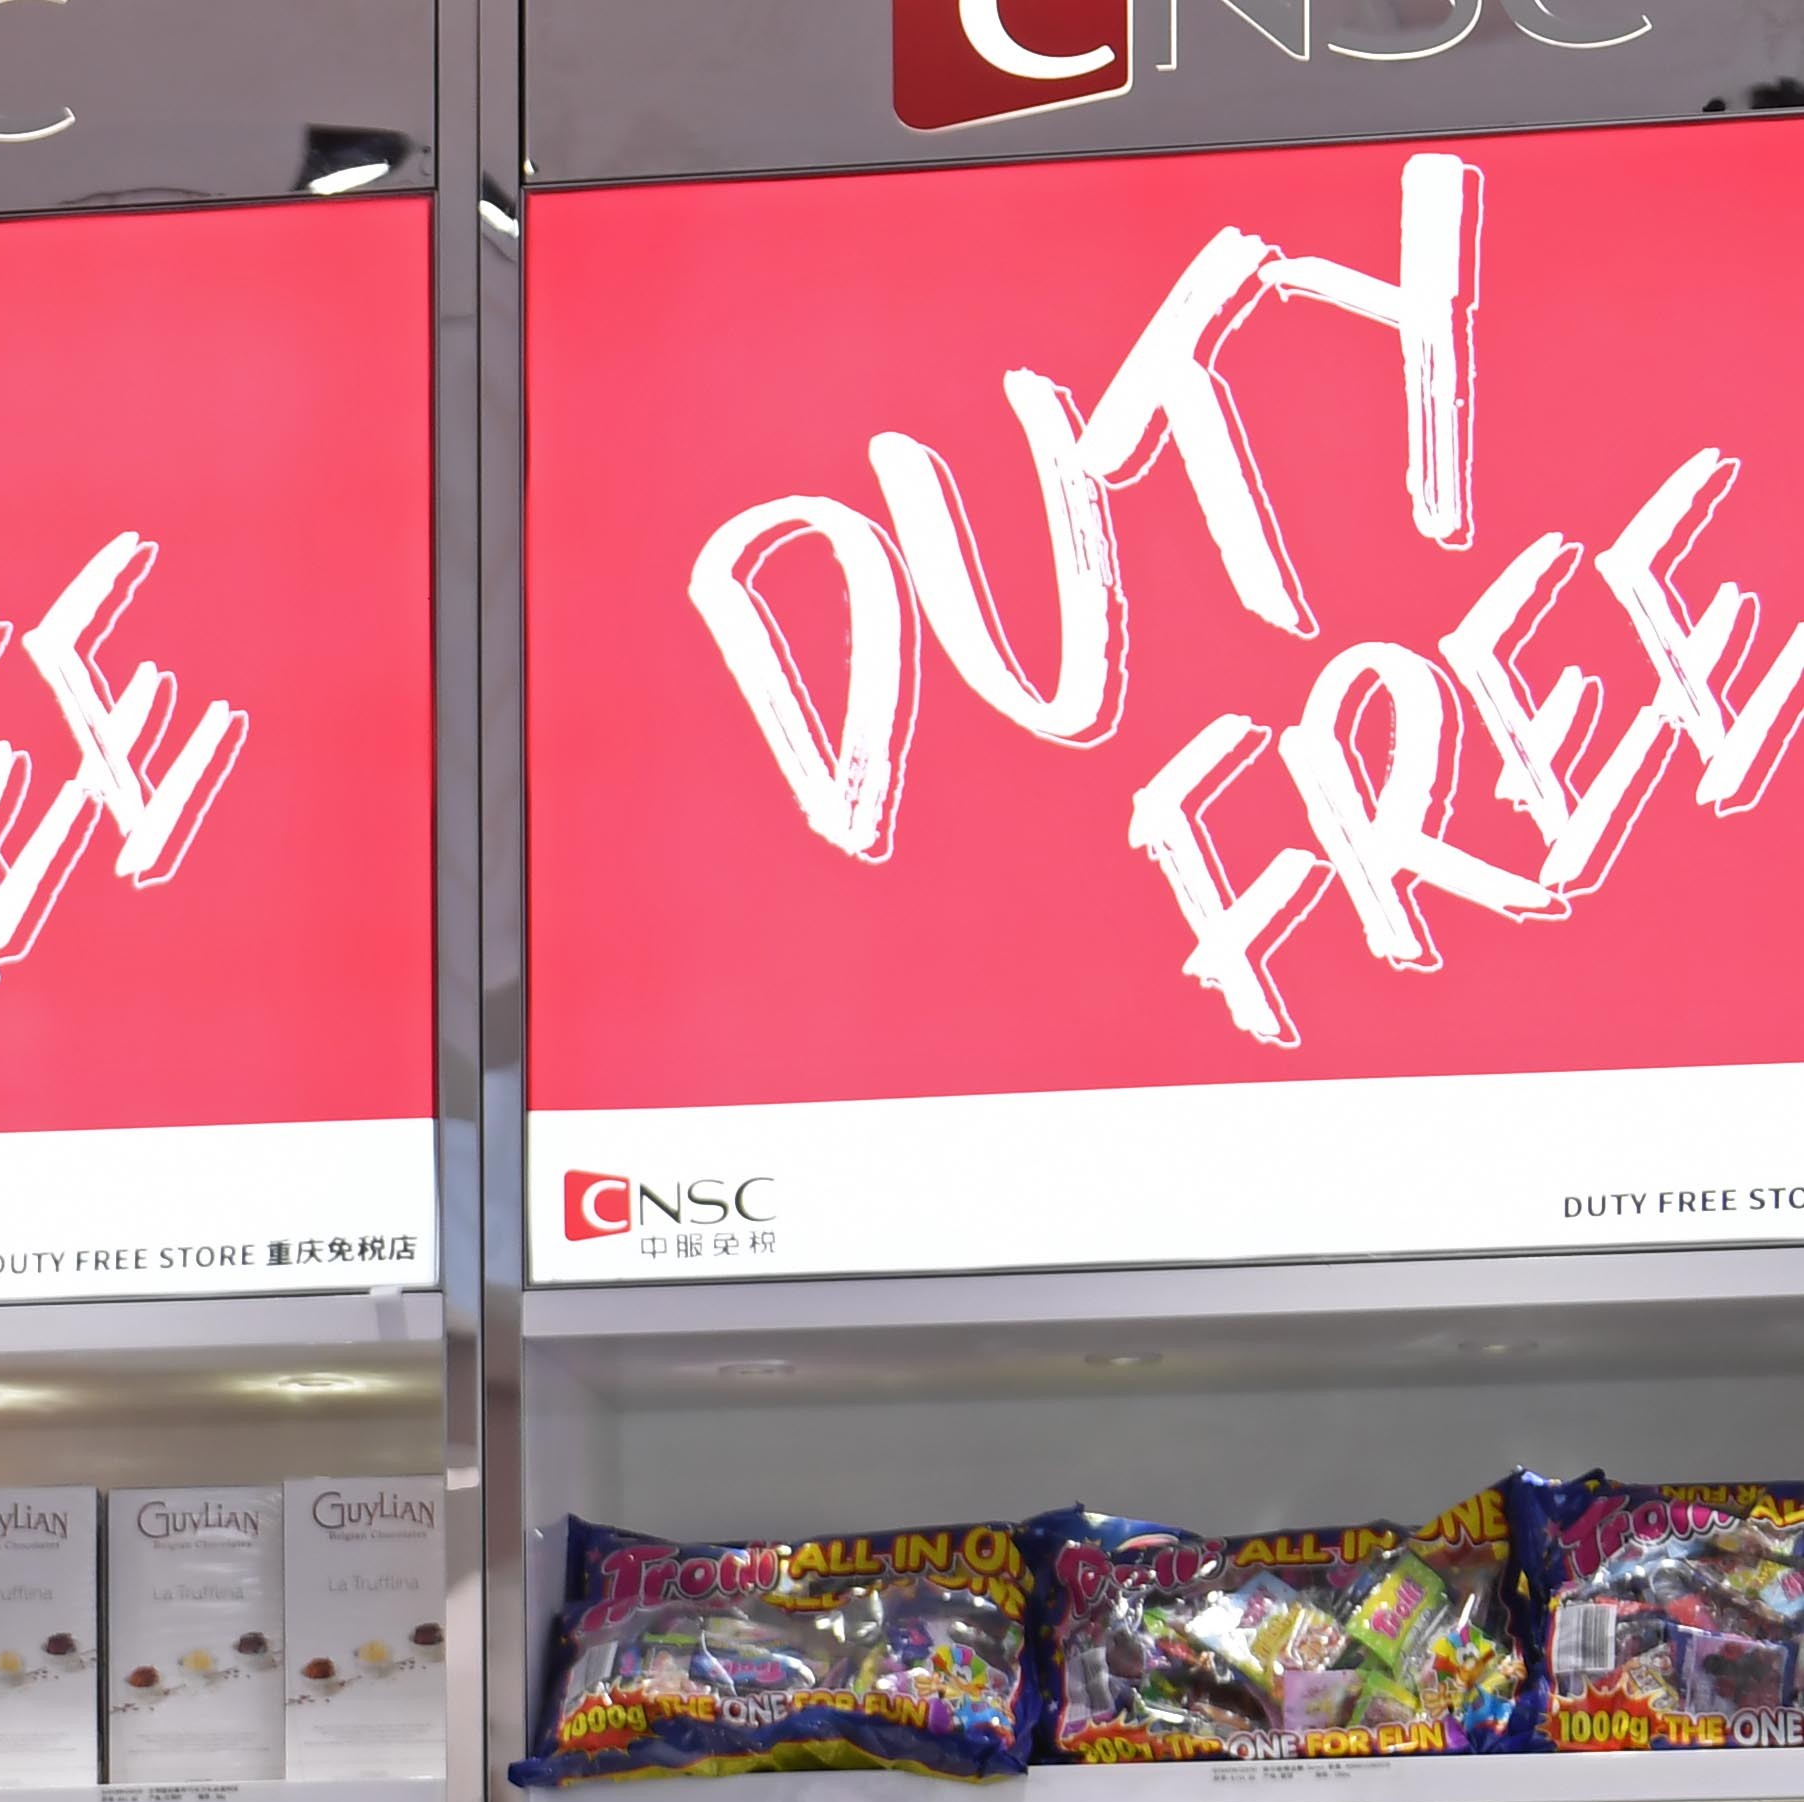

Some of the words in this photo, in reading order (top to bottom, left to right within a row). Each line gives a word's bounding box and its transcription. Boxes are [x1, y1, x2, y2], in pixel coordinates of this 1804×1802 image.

[688, 153, 1484, 864] DUTY
[1129, 446, 1804, 1048] FREE
[582, 1177, 776, 1231] CNSC
[1564, 1192, 1646, 1218] DUTY
[1659, 1189, 1736, 1213] FREE
[76, 1248, 148, 1271] FREE
[160, 1244, 256, 1268] STORE
[266, 1235, 417, 1266] 重庆免税店
[641, 1231, 776, 1260] 中服免税
[792, 1535, 878, 1577] ALL
[894, 1532, 949, 1573] IN
[1235, 1533, 1331, 1567] ALL
[1344, 1530, 1395, 1562] IN
[153, 1587, 172, 1601] La
[329, 1578, 347, 1592] La
[657, 1695, 714, 1722] THE
[723, 1696, 787, 1725] ONE
[864, 1695, 926, 1726] FUN
[1559, 1711, 1649, 1742] 1000g
[1663, 1717, 1725, 1744] THE
[1734, 1711, 1803, 1746] ONE
[1229, 1734, 1297, 1760] ONE
[1305, 1731, 1372, 1757] FOR
